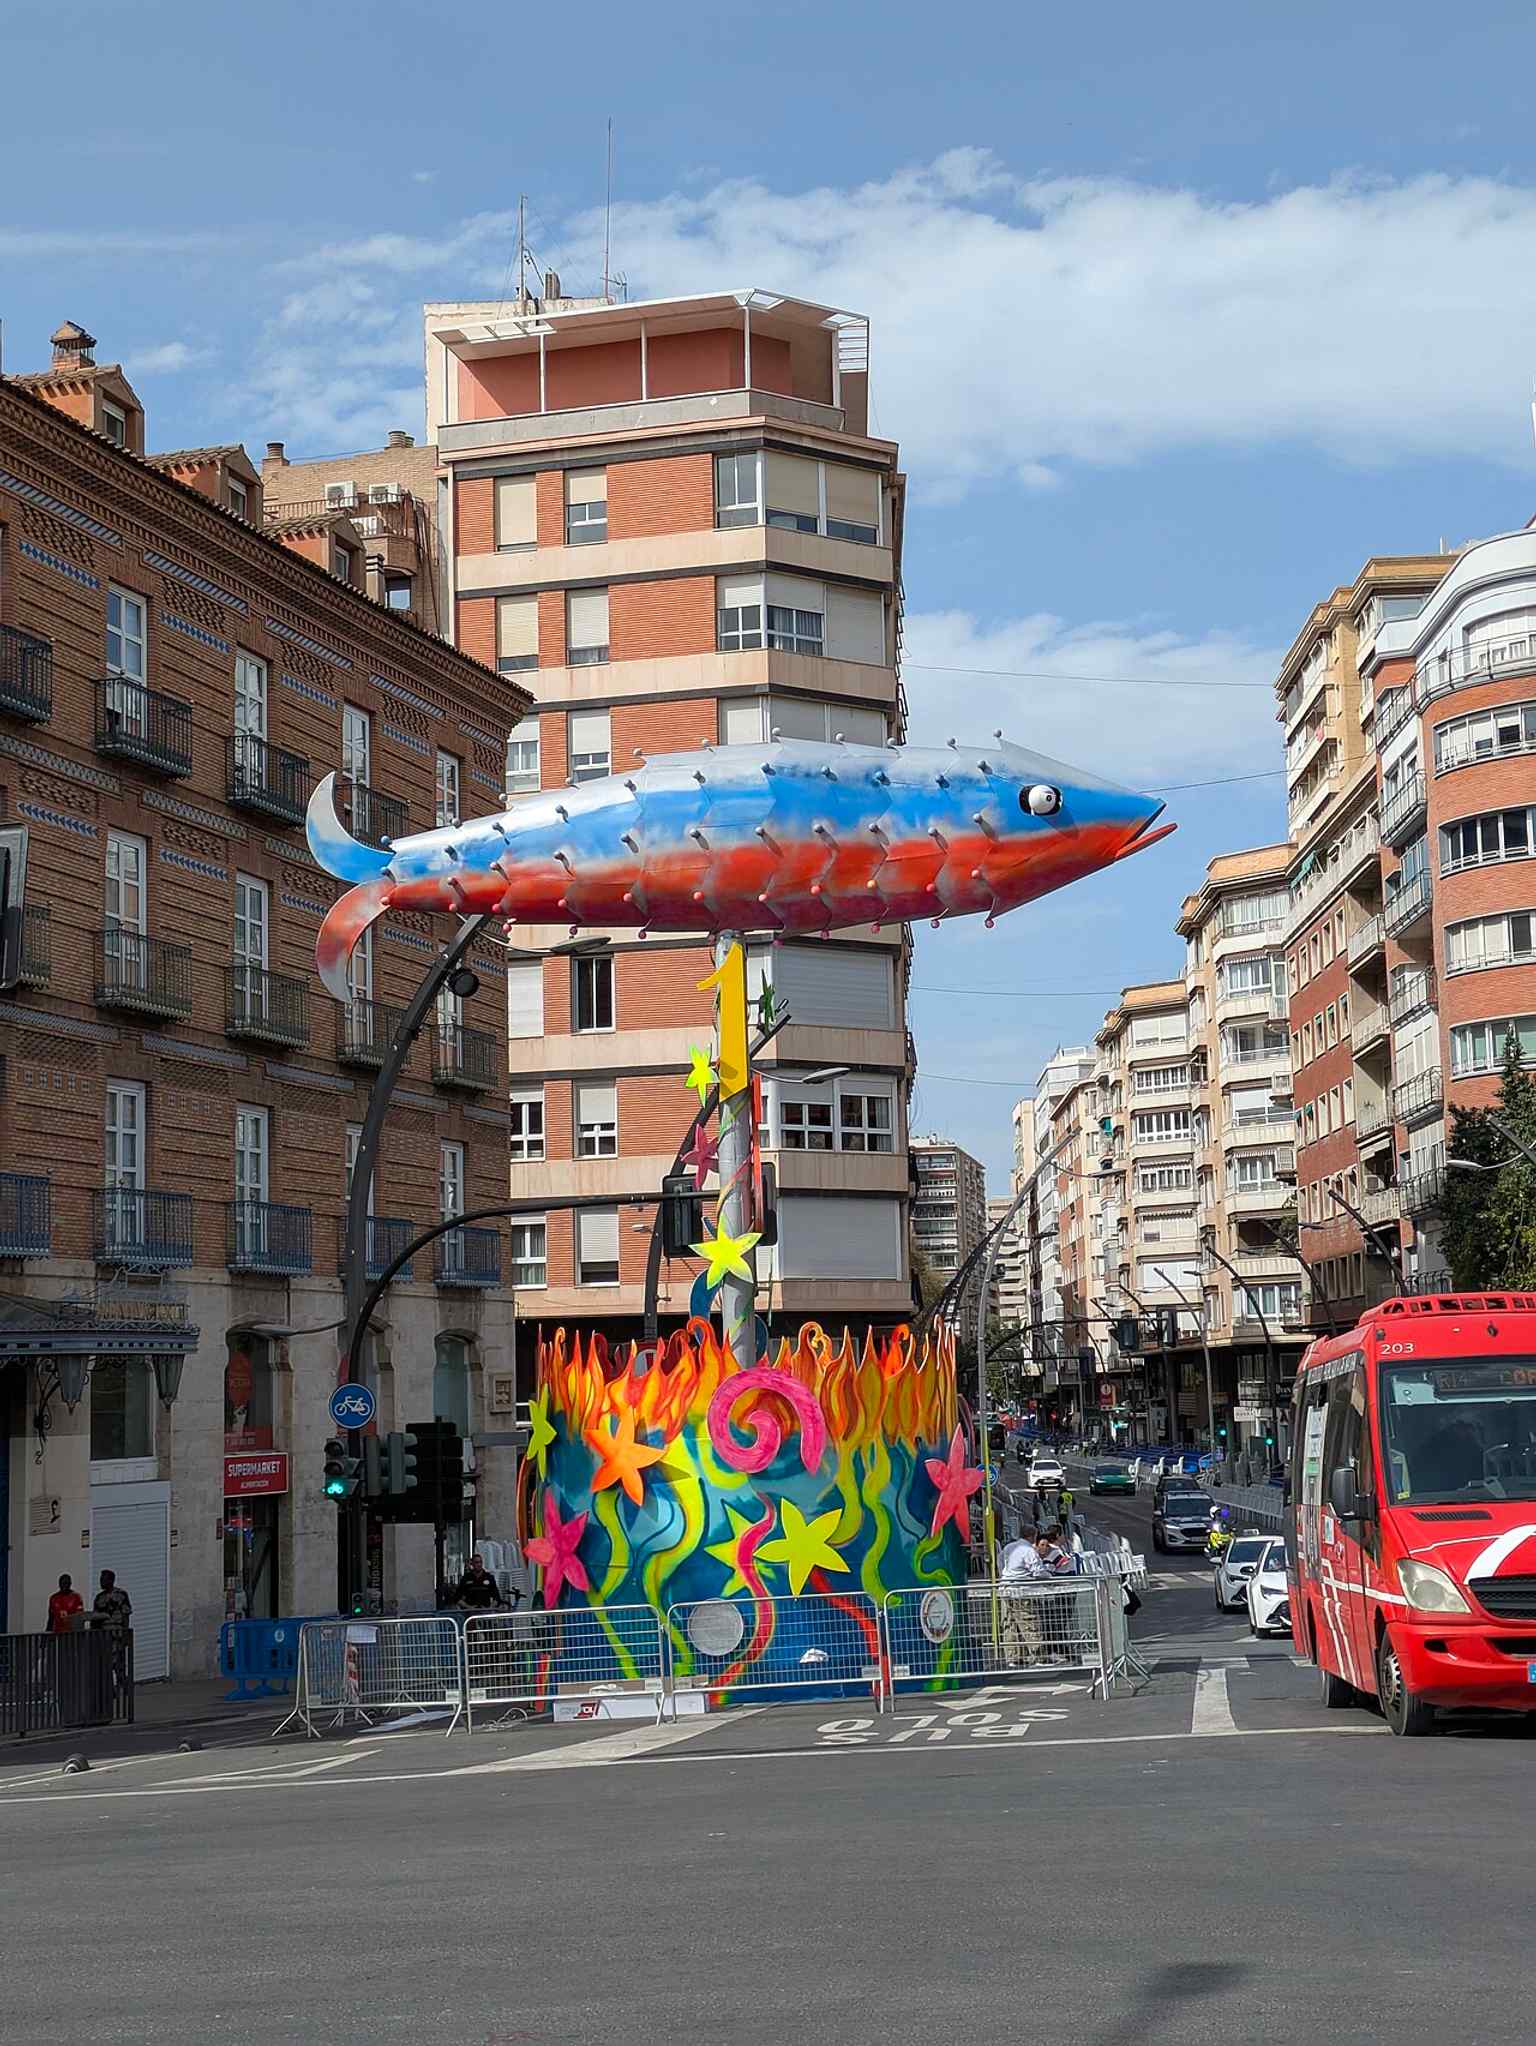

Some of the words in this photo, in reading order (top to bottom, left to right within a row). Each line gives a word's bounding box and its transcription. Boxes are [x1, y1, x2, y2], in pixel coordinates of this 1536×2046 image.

[1381, 1343, 1415, 1355] 203
[228, 1461, 281, 1478] SUPERMARKET
[817, 1709, 1070, 1733] SOLO
[813, 1723, 1030, 1745] BUS
